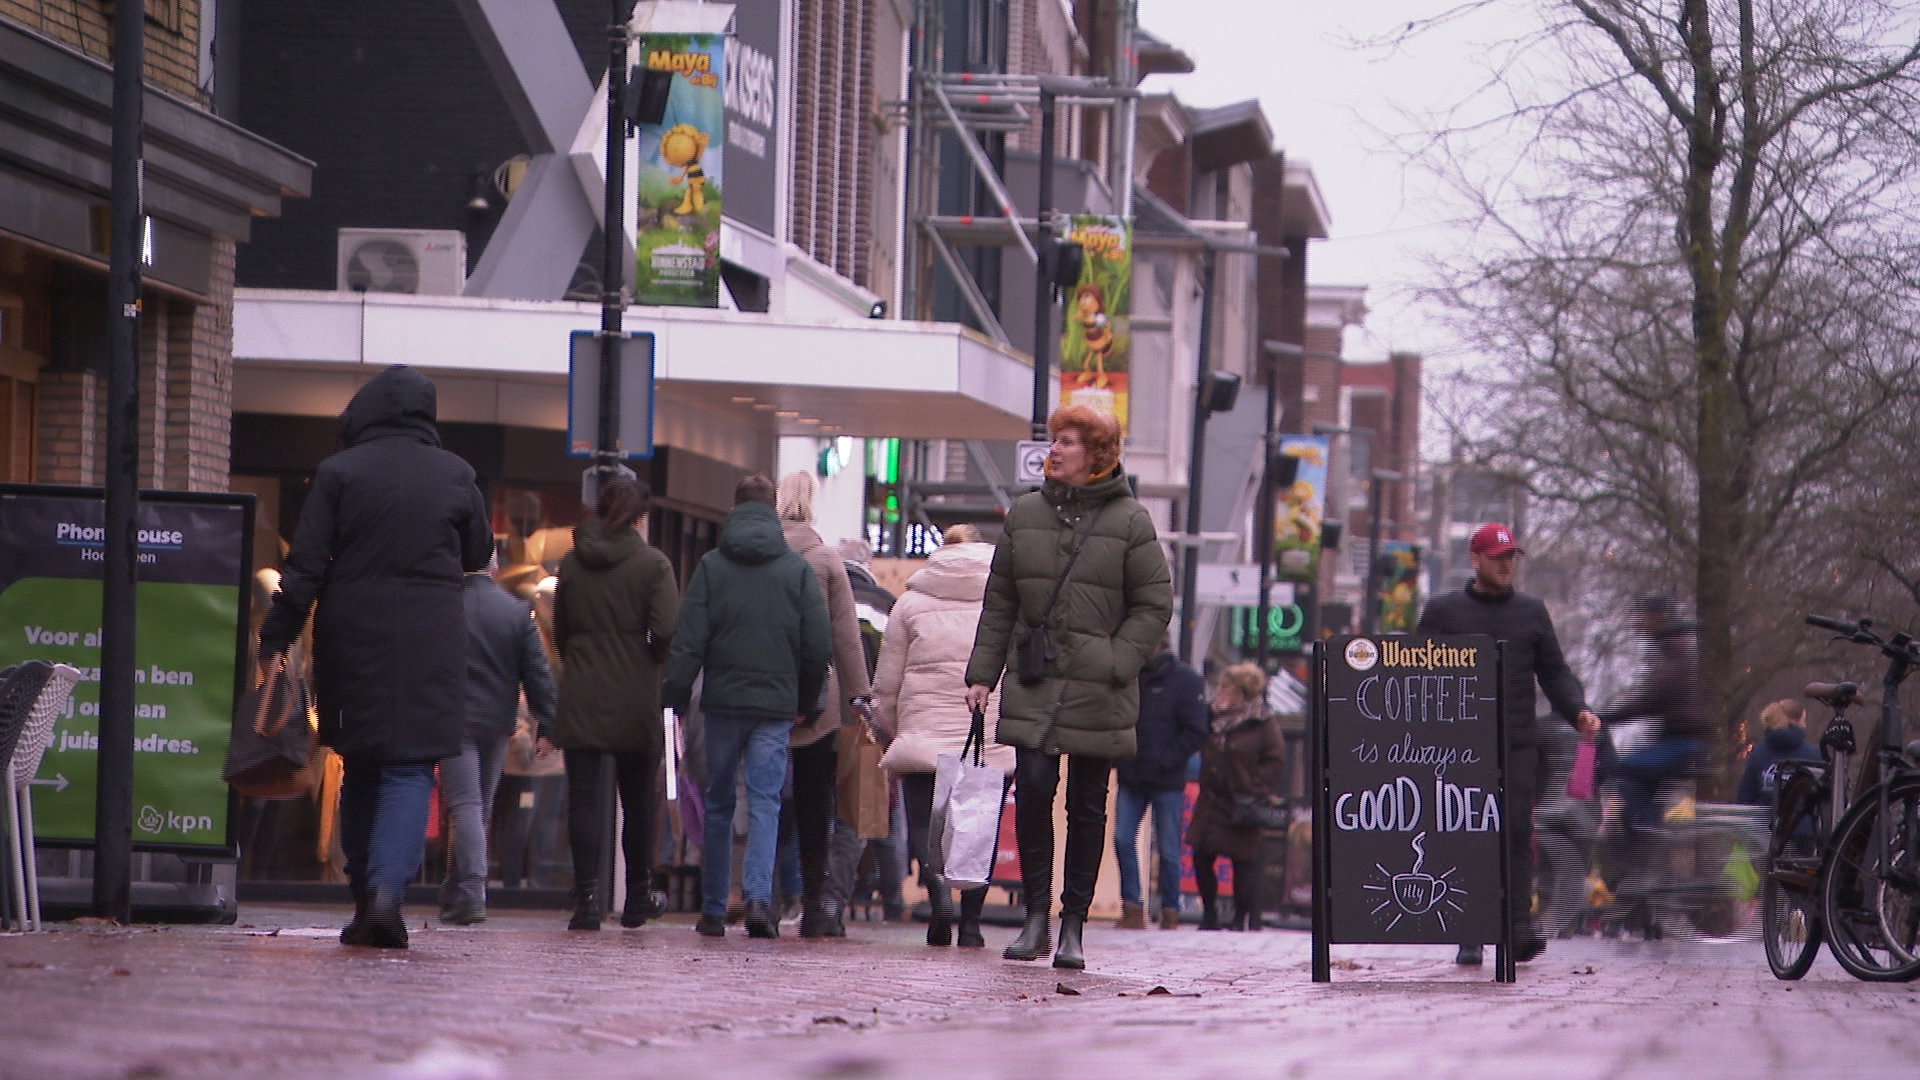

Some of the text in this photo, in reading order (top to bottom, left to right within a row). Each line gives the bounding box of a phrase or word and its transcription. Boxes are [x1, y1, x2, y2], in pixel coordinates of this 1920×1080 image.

[647, 49, 711, 77] Maya
[24, 625, 79, 647] Voor
[1381, 638, 1477, 670] Warsteiner
[151, 665, 194, 686] ben
[1356, 674, 1479, 722] COFFEE
[1351, 732, 1481, 776] is always a
[1335, 776, 1500, 832] GOOD IDEA
[168, 811, 212, 834] kpn
[1402, 883, 1424, 906] illy
